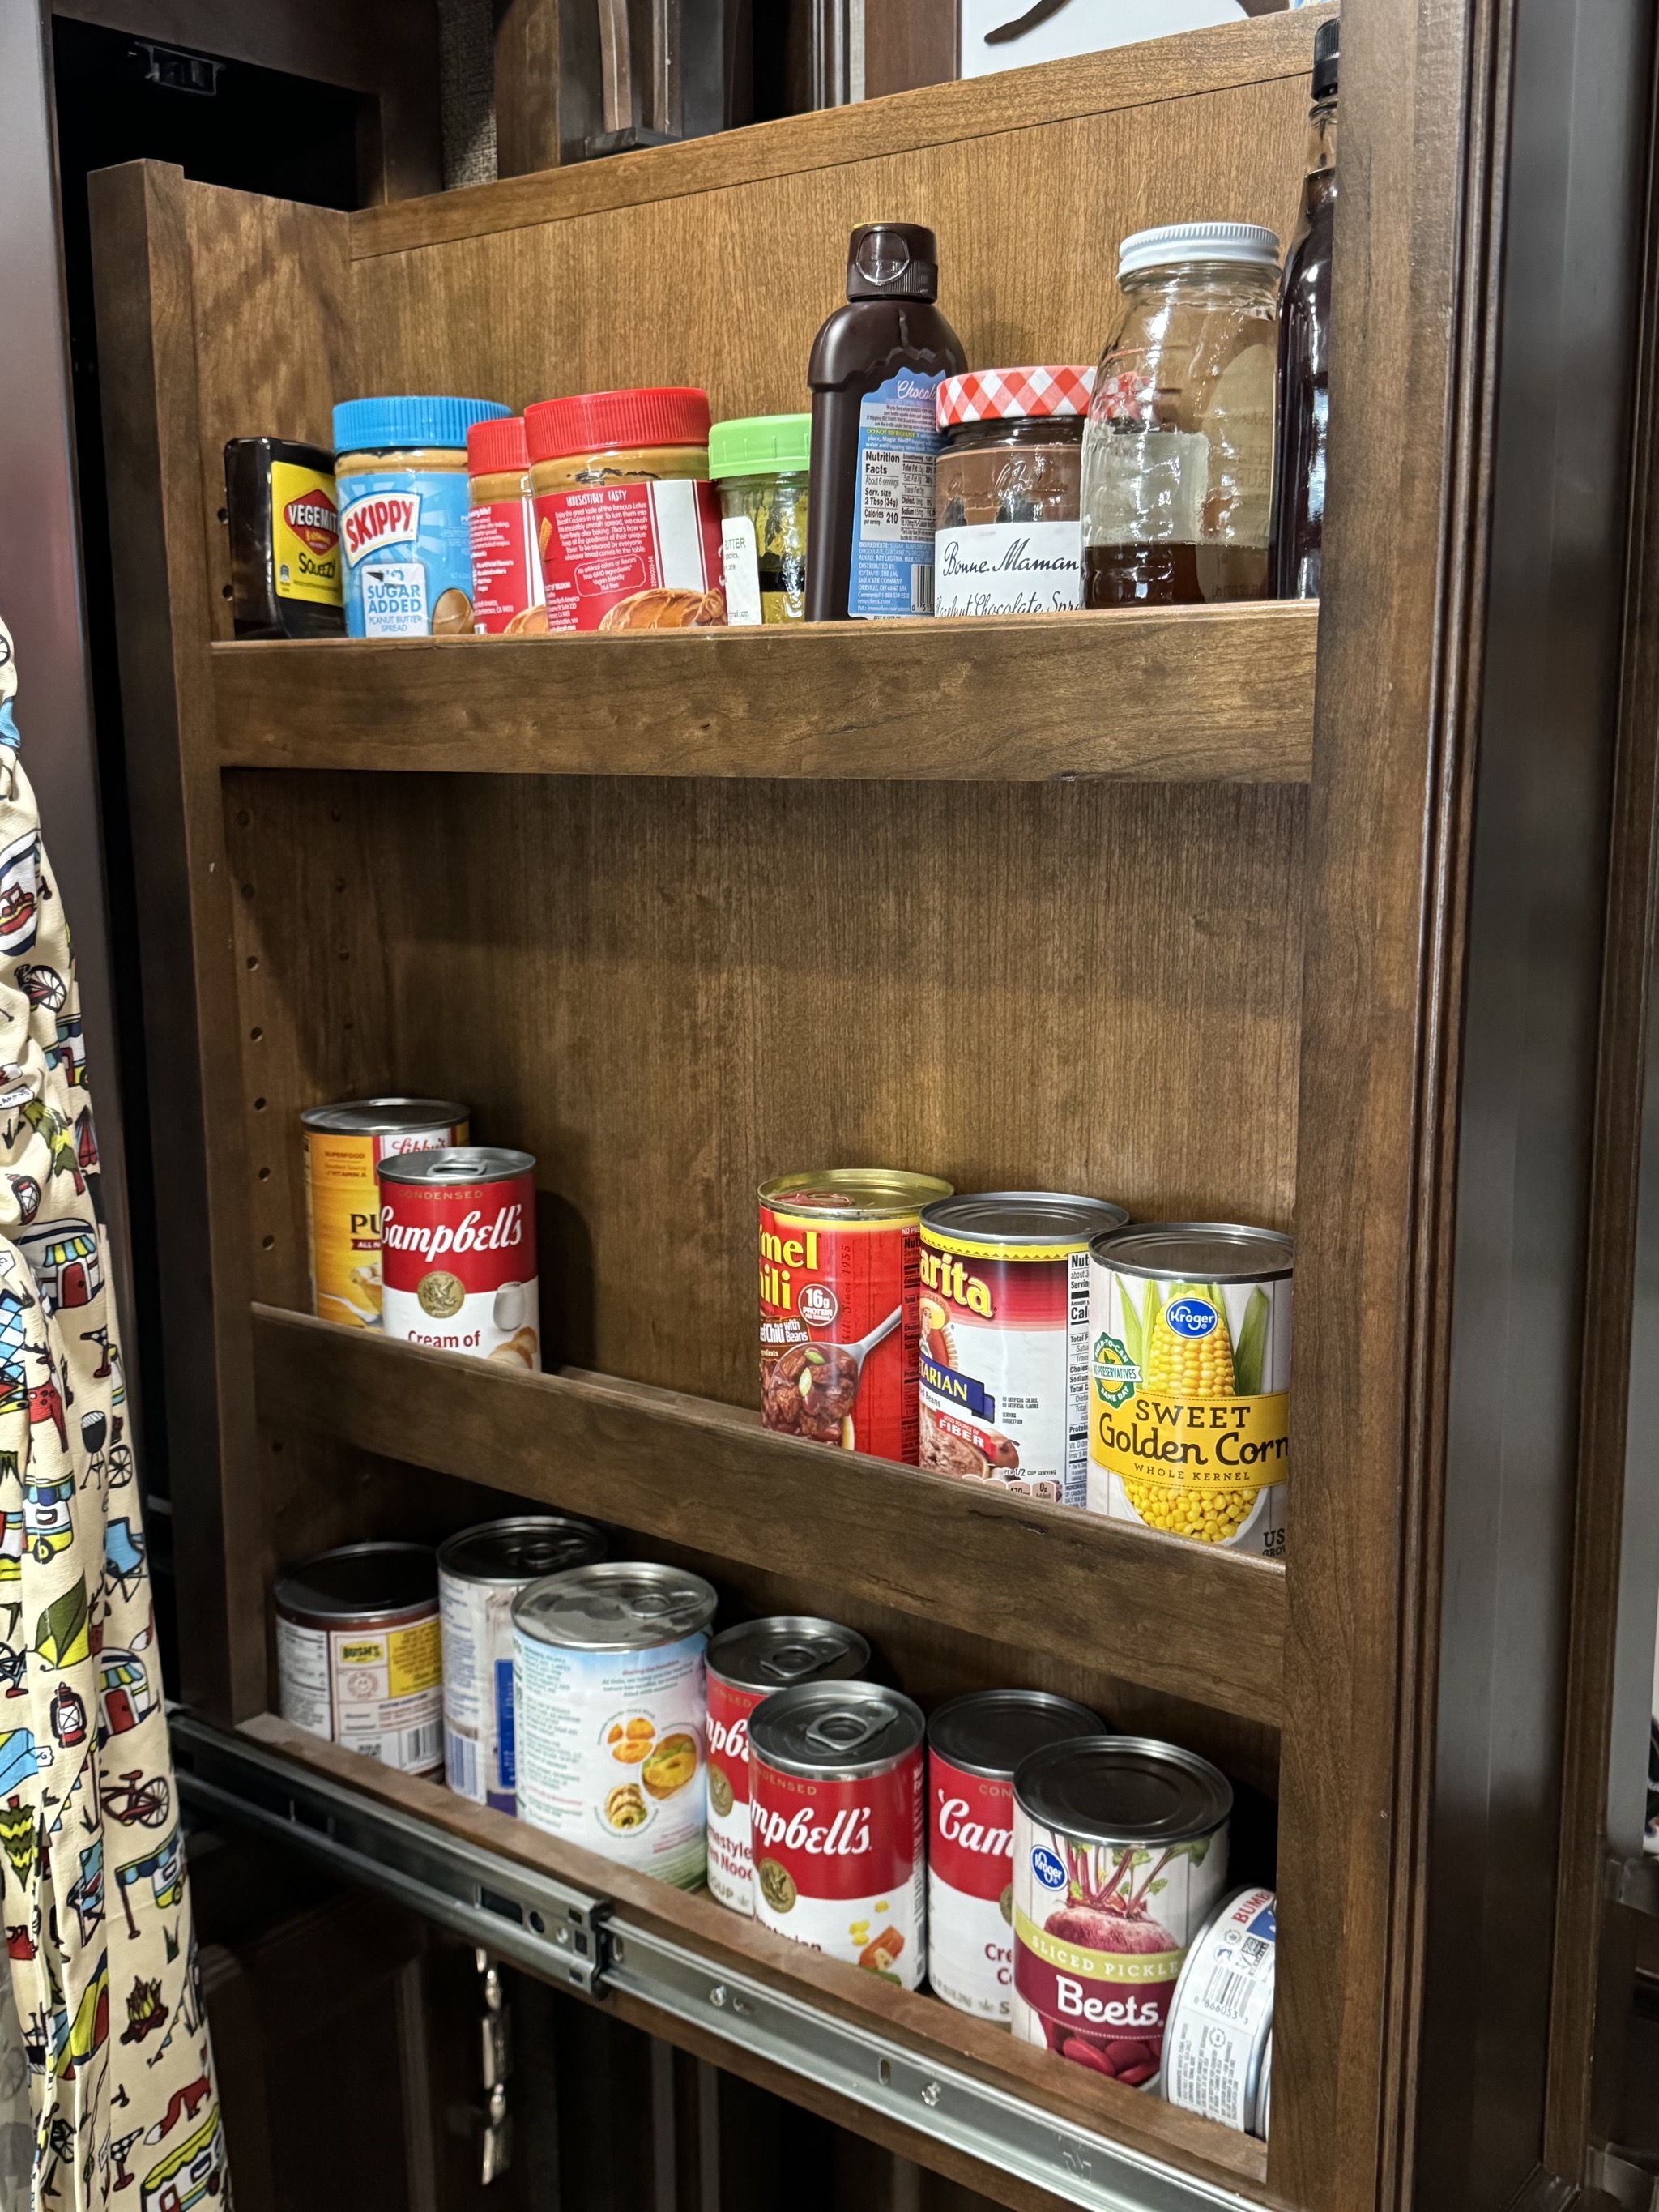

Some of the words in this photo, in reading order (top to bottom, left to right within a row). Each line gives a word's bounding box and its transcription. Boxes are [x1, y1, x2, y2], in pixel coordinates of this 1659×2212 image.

[866, 451, 900, 463] Nutrition
[866, 463, 887, 474] Facts
[866, 476, 878, 485] About
[882, 478, 899, 489] servings
[566, 492, 604, 507] IRRESISTIBLY
[608, 490, 627, 502] TASTY
[865, 487, 880, 496] Serv.
[881, 489, 891, 497] size
[870, 497, 884, 507] Tbsp
[884, 498, 898, 508] (34g)
[288, 504, 338, 533] VEGEMIT
[573, 508, 585, 517] great
[864, 508, 884, 518] Calories
[886, 512, 898, 524] 210
[345, 500, 414, 553] SKIPPY
[604, 519, 623, 529] spread,
[585, 536, 609, 544] goodness
[943, 541, 990, 576] Bonne
[992, 537, 1080, 572] Maman
[584, 564, 601, 572] artificial
[367, 584, 422, 599] SUGAR
[368, 600, 422, 613] ADDED
[369, 615, 395, 624] PEANUT
[396, 615, 423, 624] BUTTER
[382, 623, 407, 632] SPREAD
[398, 1189, 484, 1200] CONDENSED
[350, 1213, 381, 1234] PU
[380, 1204, 524, 1262] Campbell's
[841, 1244, 851, 1274] 1935
[1071, 1254, 1089, 1268] Nut
[1070, 1271, 1085, 1279] about
[921, 1249, 993, 1317] arita
[805, 1288, 830, 1310] 16g
[841, 1282, 851, 1314] Since
[803, 1307, 833, 1317] PROTEIN
[1071, 1306, 1089, 1320] Cal
[1169, 1306, 1215, 1332] Kroger
[784, 1319, 800, 1332] with
[408, 1332, 460, 1348] Cream
[463, 1330, 481, 1347] of
[766, 1323, 783, 1344] Chili
[785, 1330, 809, 1343] Beans
[1070, 1375, 1088, 1383] Sodium
[1098, 1365, 1137, 1379] PRESERVATIVES
[1069, 1385, 1084, 1393] Total
[1101, 1388, 1117, 1402] SAME
[1117, 1386, 1129, 1400] DAY
[925, 1391, 941, 1408] Beans
[1075, 1404, 1088, 1412] Total
[1135, 1399, 1251, 1429] SWEET
[943, 1414, 956, 1425] GOOD
[955, 1420, 972, 1433] SOURCE
[972, 1427, 980, 1436] OF
[1069, 1424, 1088, 1433] Protein
[938, 1419, 985, 1448] FIBER
[1099, 1413, 1207, 1465] Golden
[1215, 1432, 1288, 1466] Corn
[1015, 1468, 1026, 1476] 1/2
[1134, 1463, 1186, 1480] WHOLE
[1193, 1471, 1251, 1482] KERNEL
[343, 1645, 380, 1659] BUSH'S
[978, 1784, 1013, 1798] CON
[751, 1798, 872, 1855] mpbell's
[938, 1788, 1013, 1858] Cam
[1034, 1852, 1062, 1883] Kroger
[985, 1943, 1012, 1963] Cre
[1032, 1935, 1094, 1972] SLICED
[1105, 1961, 1179, 1977] PICKLE
[1056, 1975, 1159, 2026] Beets
[1204, 2000, 1238, 2020] 866053
